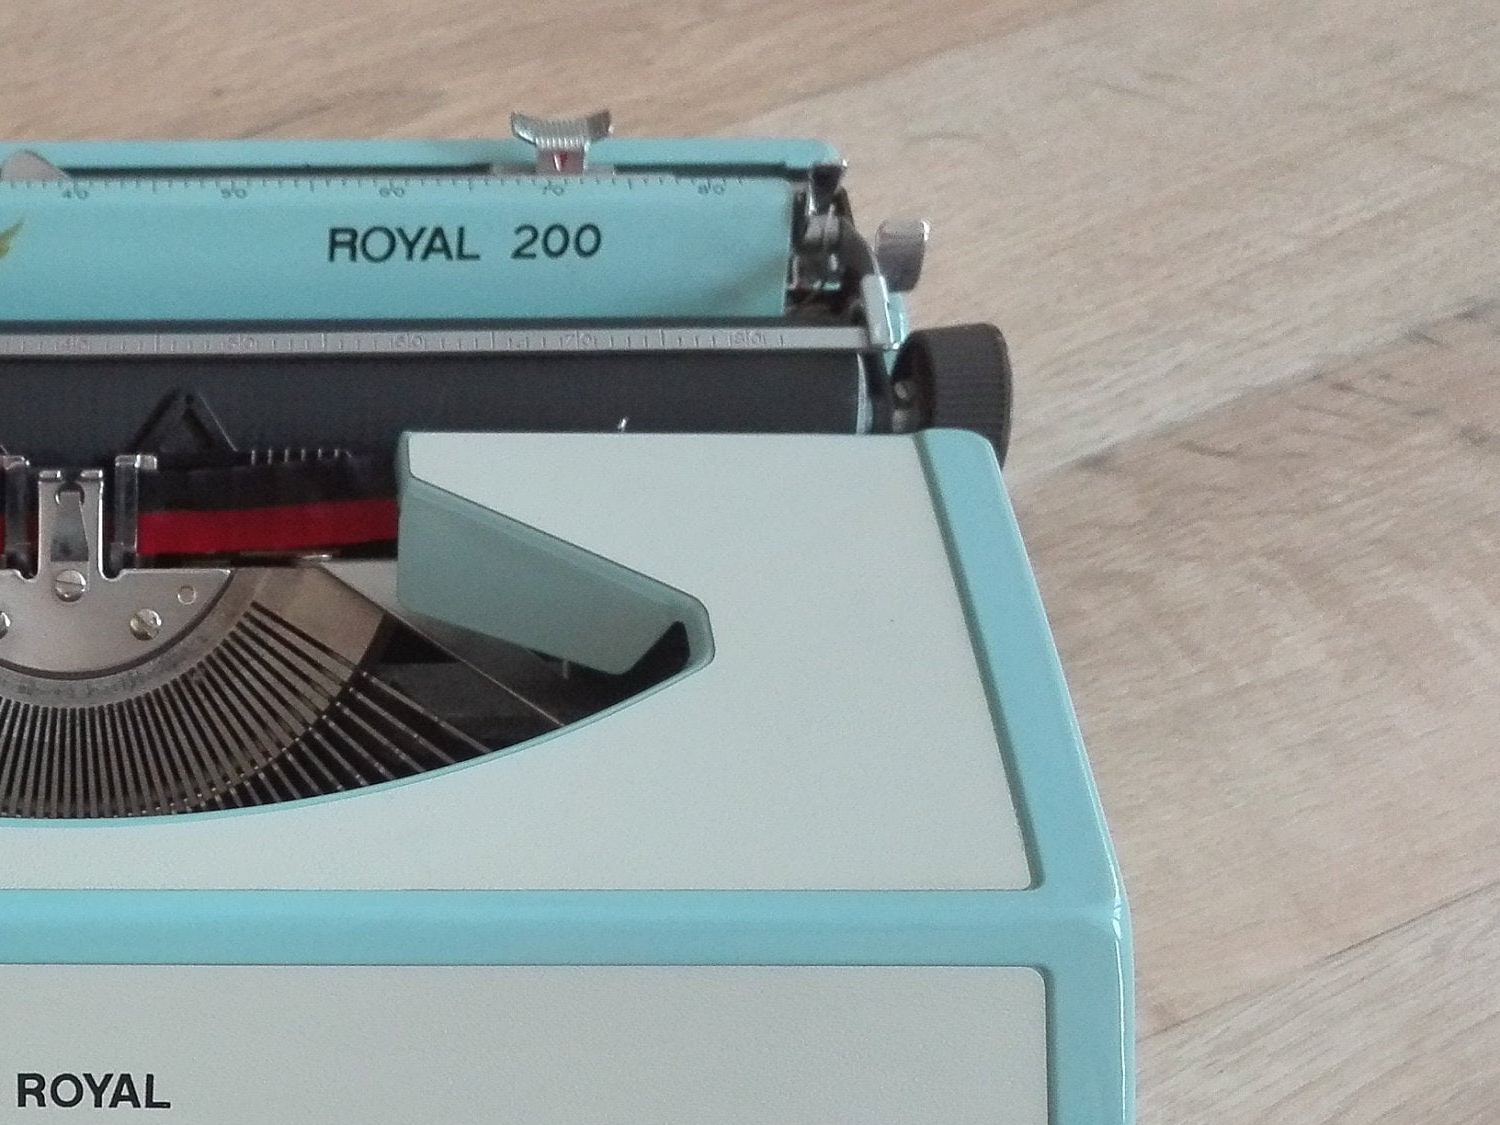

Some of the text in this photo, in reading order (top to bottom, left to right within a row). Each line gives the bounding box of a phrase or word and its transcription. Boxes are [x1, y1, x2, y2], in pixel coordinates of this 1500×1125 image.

[328, 223, 602, 263] ROYAL 200
[17, 1072, 171, 1109] ROYAL
